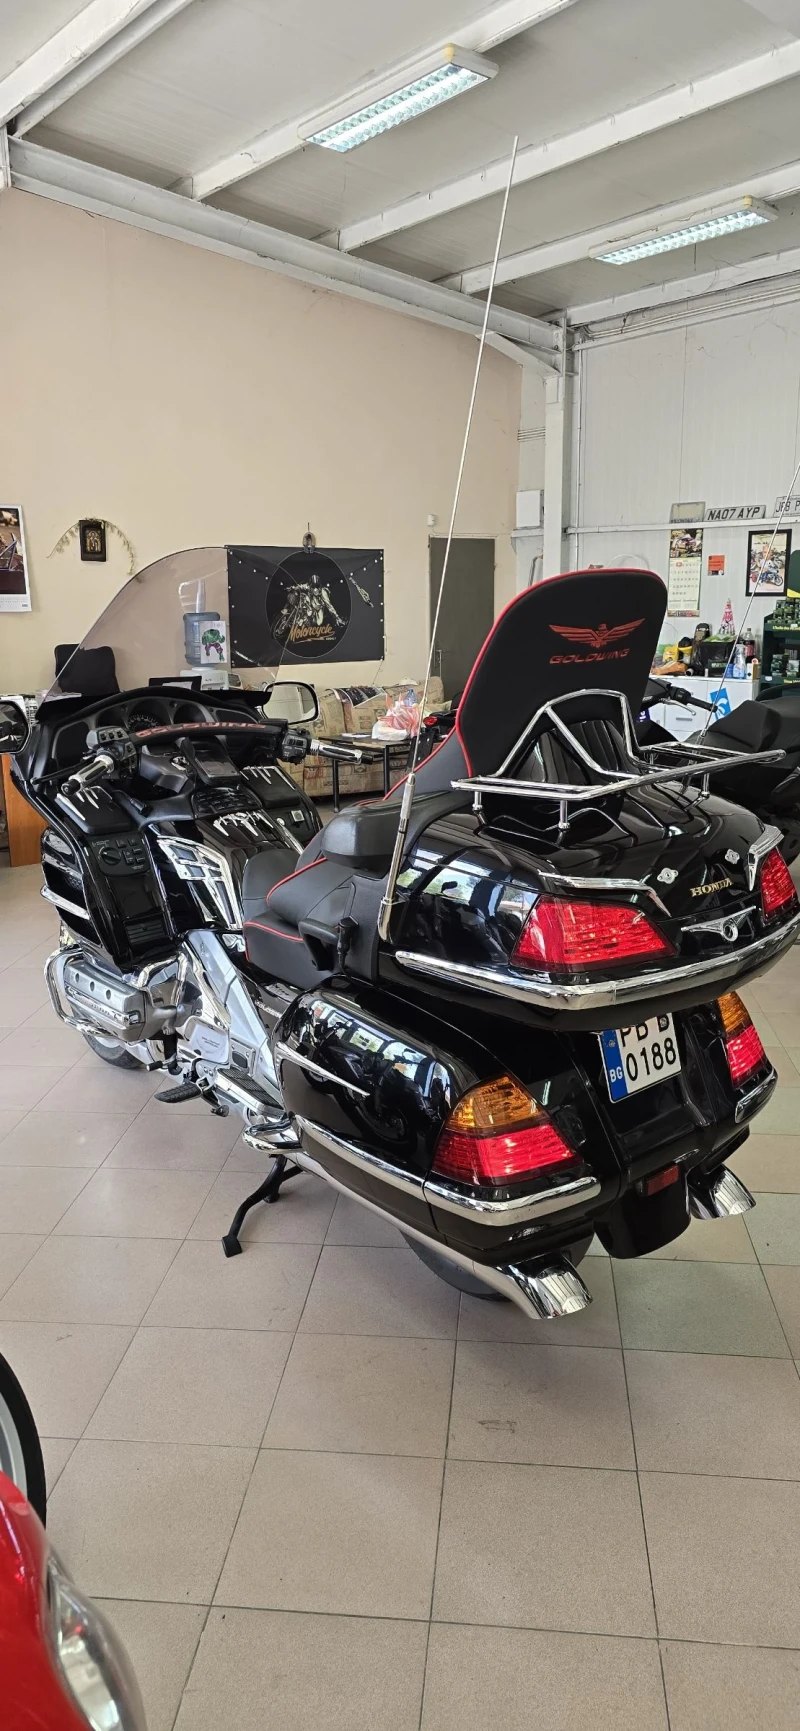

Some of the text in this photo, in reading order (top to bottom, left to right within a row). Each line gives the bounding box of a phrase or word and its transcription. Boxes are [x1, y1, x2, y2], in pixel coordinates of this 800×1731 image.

[708, 506, 760, 520] NA07 AYP
[290, 624, 333, 642] Motorcycle
[549, 648, 630, 664] GOLDWING
[135, 721, 267, 738] GOLDWING
[690, 877, 734, 897] HONDA
[626, 1037, 676, 1081] 0188
[609, 1066, 623, 1083] BG
